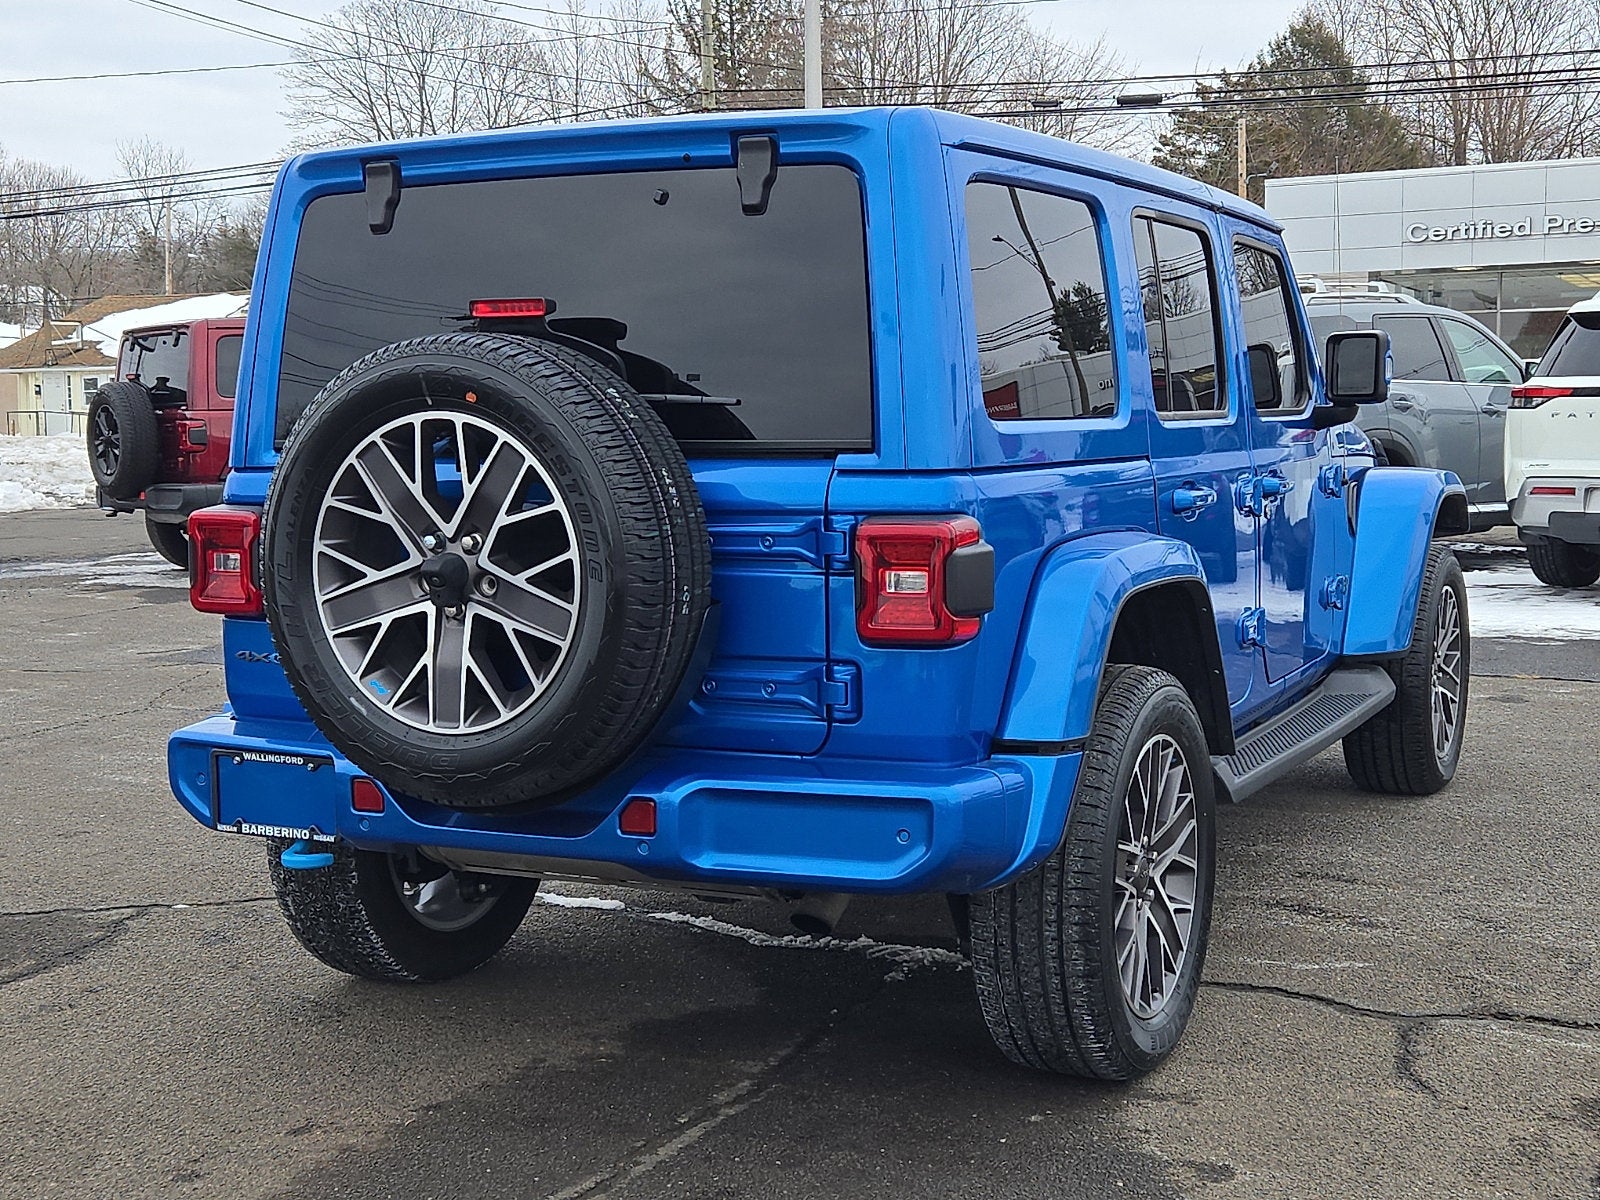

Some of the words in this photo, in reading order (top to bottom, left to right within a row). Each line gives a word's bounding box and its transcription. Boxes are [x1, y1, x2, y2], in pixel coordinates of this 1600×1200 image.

[1406, 216, 1532, 242] Certified
[302, 662, 460, 770] DUELER
[242, 752, 304, 765] WALLINGFORD
[241, 823, 310, 839] BARBERINO
